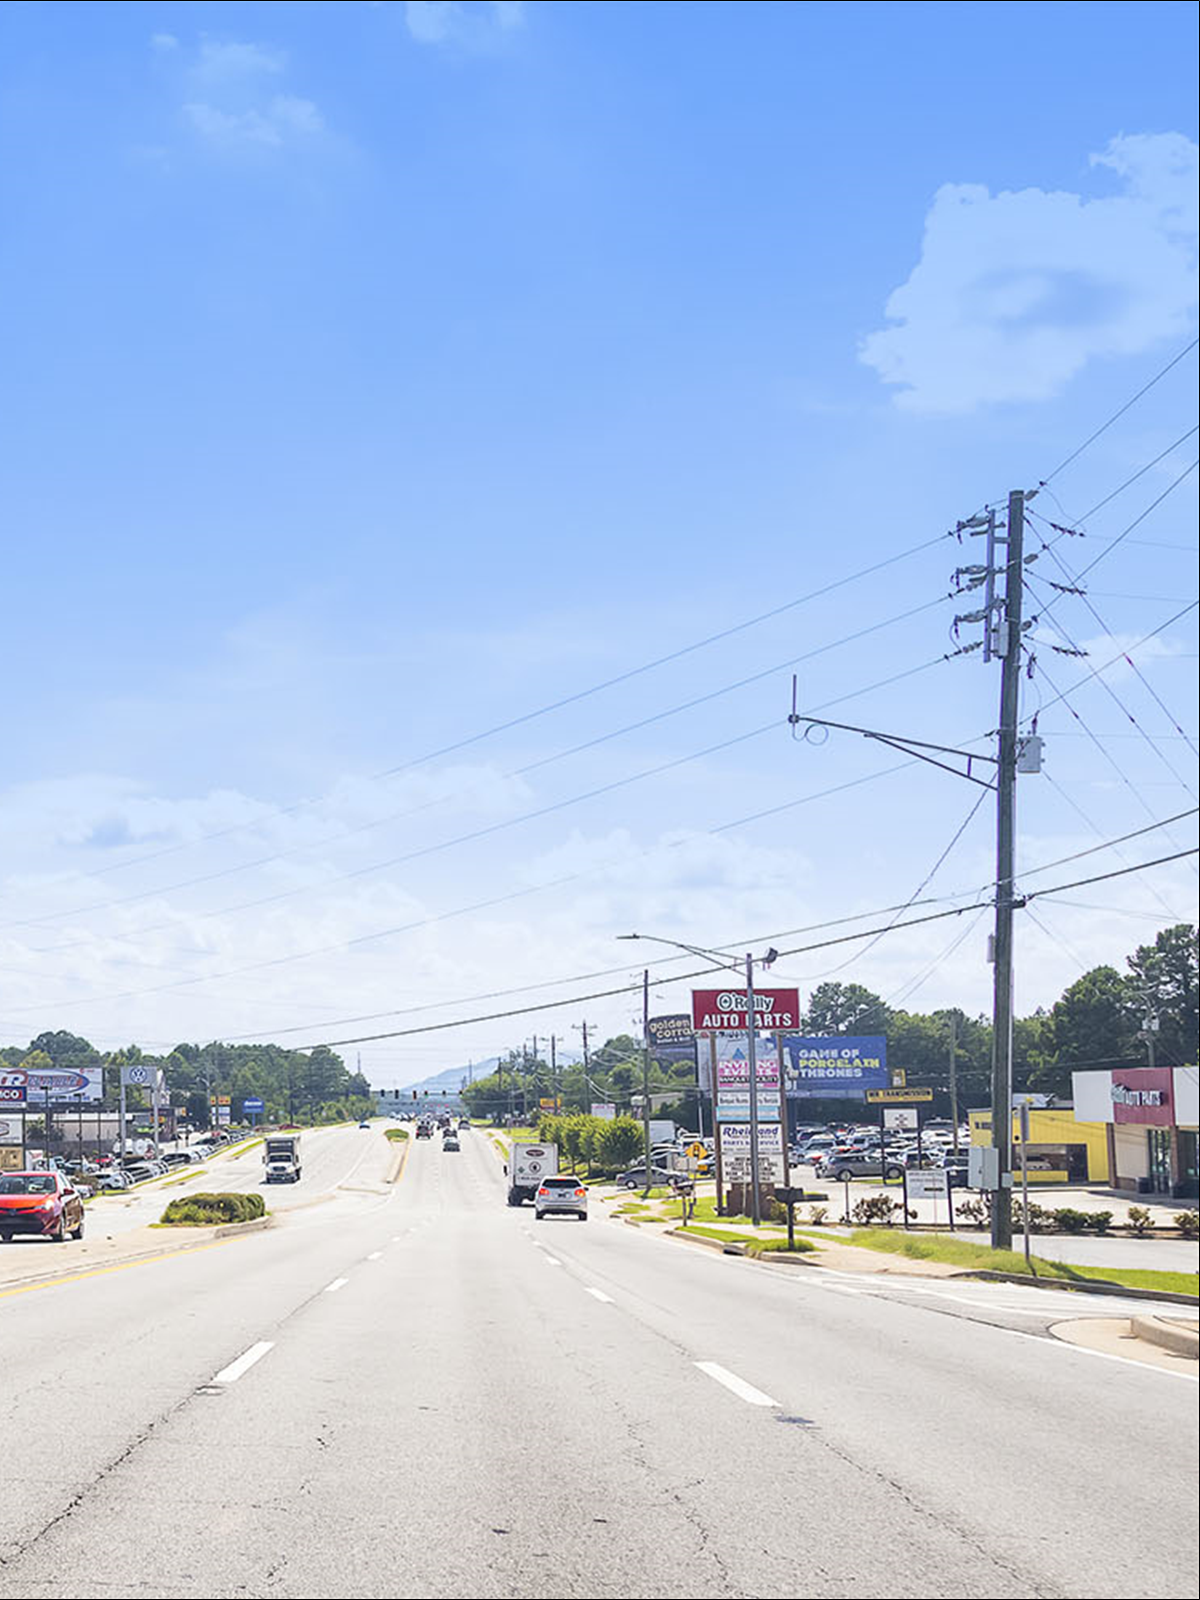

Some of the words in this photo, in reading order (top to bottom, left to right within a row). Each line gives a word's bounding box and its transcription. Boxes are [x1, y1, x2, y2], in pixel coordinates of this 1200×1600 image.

[717, 992, 774, 1012] O'Relly
[702, 1014, 739, 1027] AUTO
[649, 1020, 690, 1033] golden
[656, 1028, 692, 1038] corra
[799, 1049, 838, 1058] GAME
[841, 1049, 859, 1058] OF
[799, 1059, 879, 1068] PORCELAIN
[800, 1068, 863, 1077] THRONES
[723, 1126, 779, 1138] Rheiand
